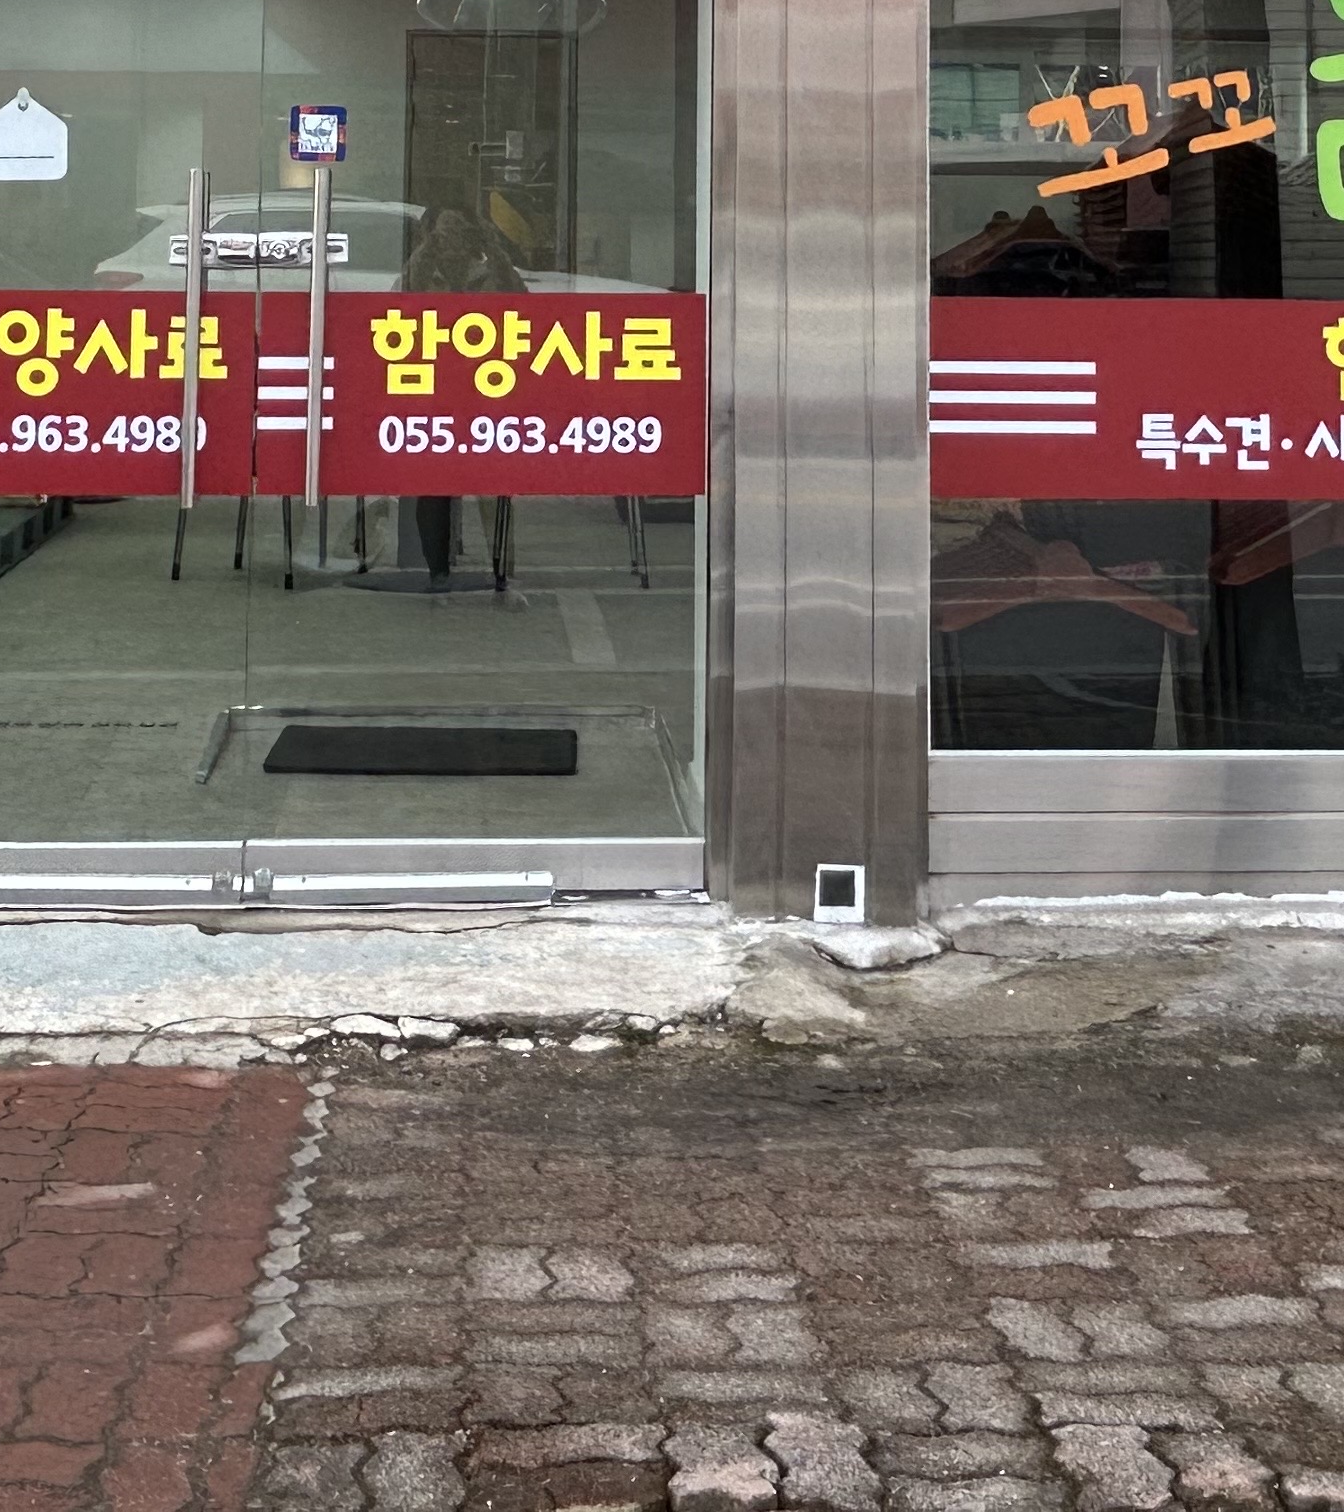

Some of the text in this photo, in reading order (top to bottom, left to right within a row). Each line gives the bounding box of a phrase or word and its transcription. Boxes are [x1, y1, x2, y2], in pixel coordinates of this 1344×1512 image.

[1027, 70, 1276, 197] 꼬꼬
[370, 308, 682, 399] 함양사료
[378, 415, 664, 456] 055.963.4989
